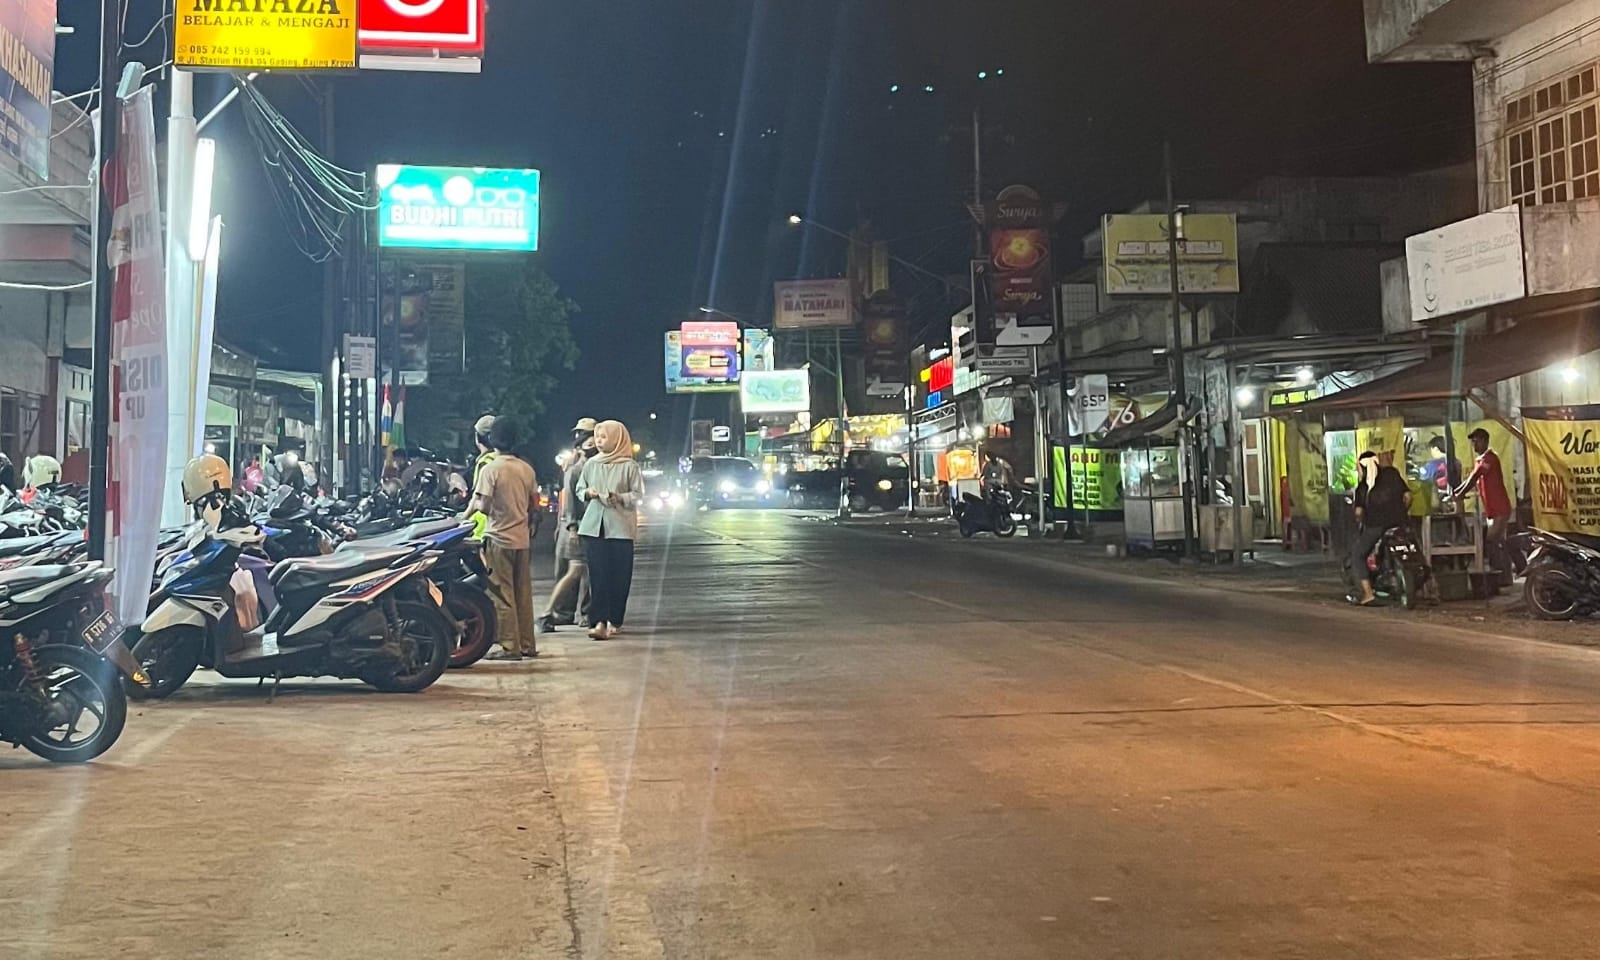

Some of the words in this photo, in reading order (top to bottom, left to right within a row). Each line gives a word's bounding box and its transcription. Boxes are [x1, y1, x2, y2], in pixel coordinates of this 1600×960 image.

[184, 15, 255, 27] BELAJAR
[260, 16, 271, 27] &
[278, 17, 350, 29] MENGAJI
[190, 45, 208, 54] 085
[211, 46, 229, 55] 742
[997, 204, 1042, 222] Surya
[1003, 288, 1042, 303] Surya
[784, 299, 846, 311] MATAHARI
[1109, 401, 1135, 431] 76
[1573, 466, 1594, 474] NASI
